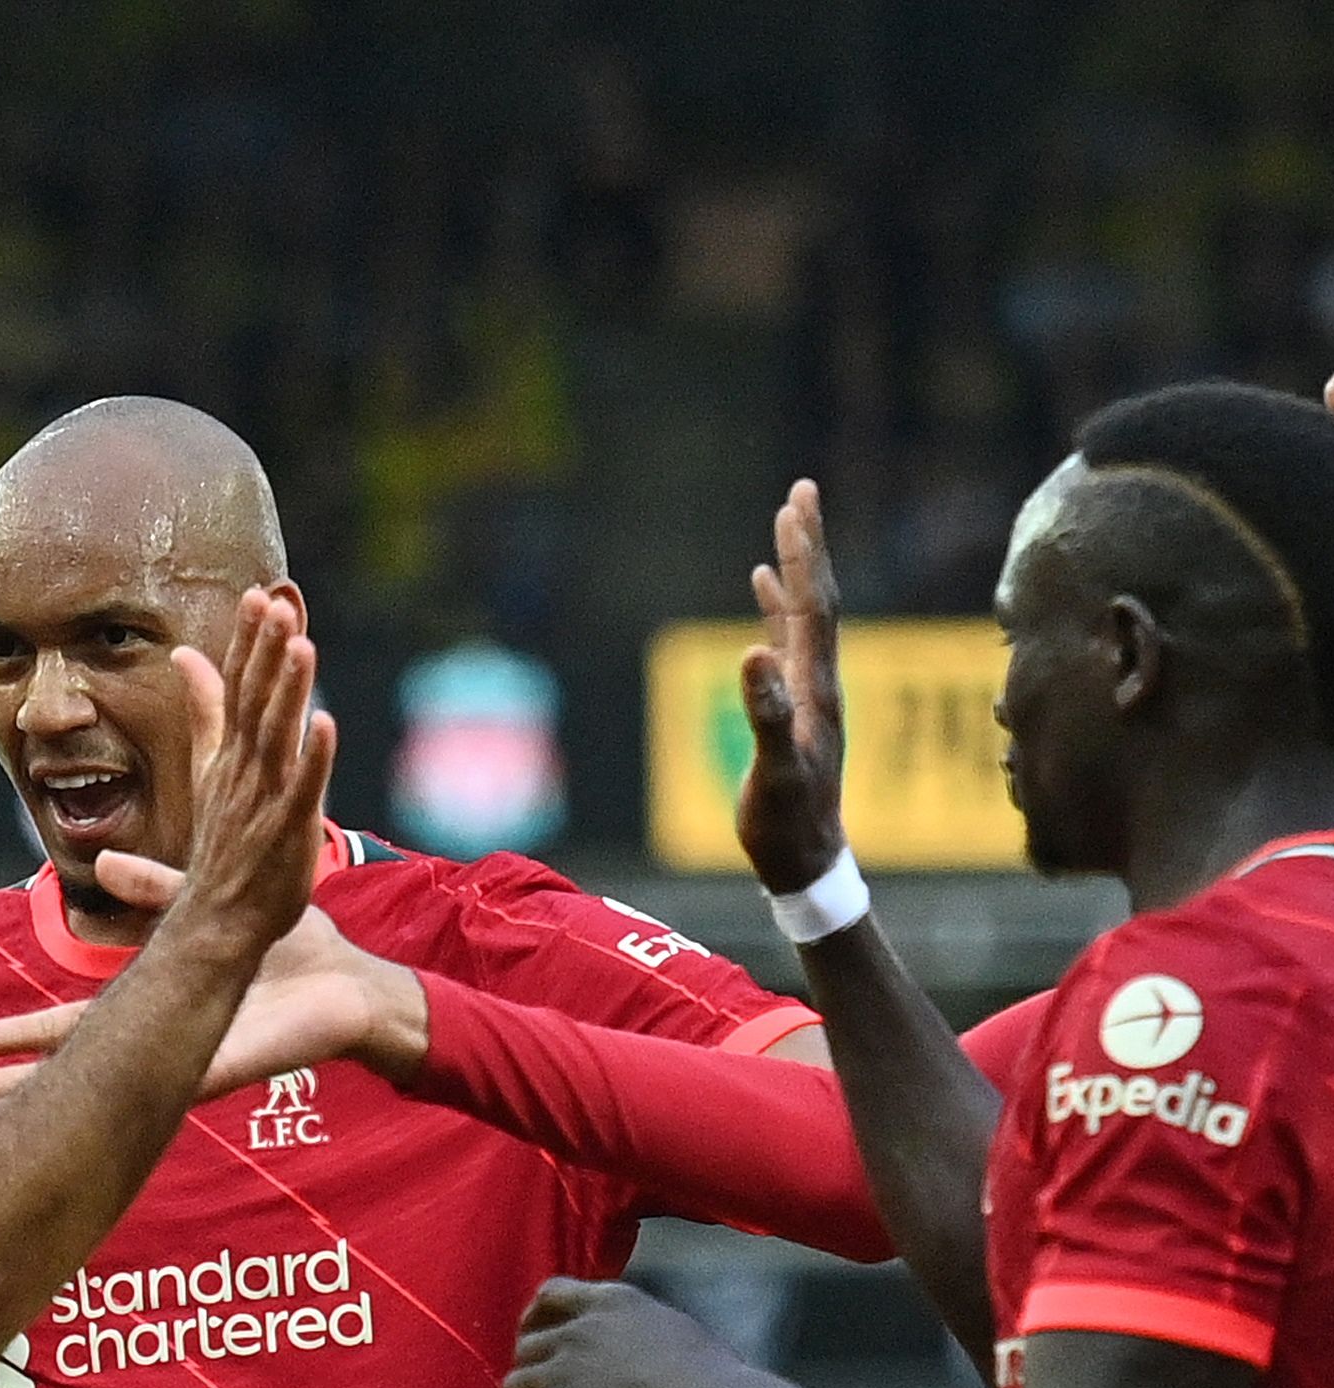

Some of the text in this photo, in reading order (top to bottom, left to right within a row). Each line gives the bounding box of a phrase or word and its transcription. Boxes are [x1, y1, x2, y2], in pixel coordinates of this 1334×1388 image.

[1045, 1061, 1250, 1147] Expedia
[51, 1237, 351, 1324] standard
[55, 1291, 374, 1378] chartered
